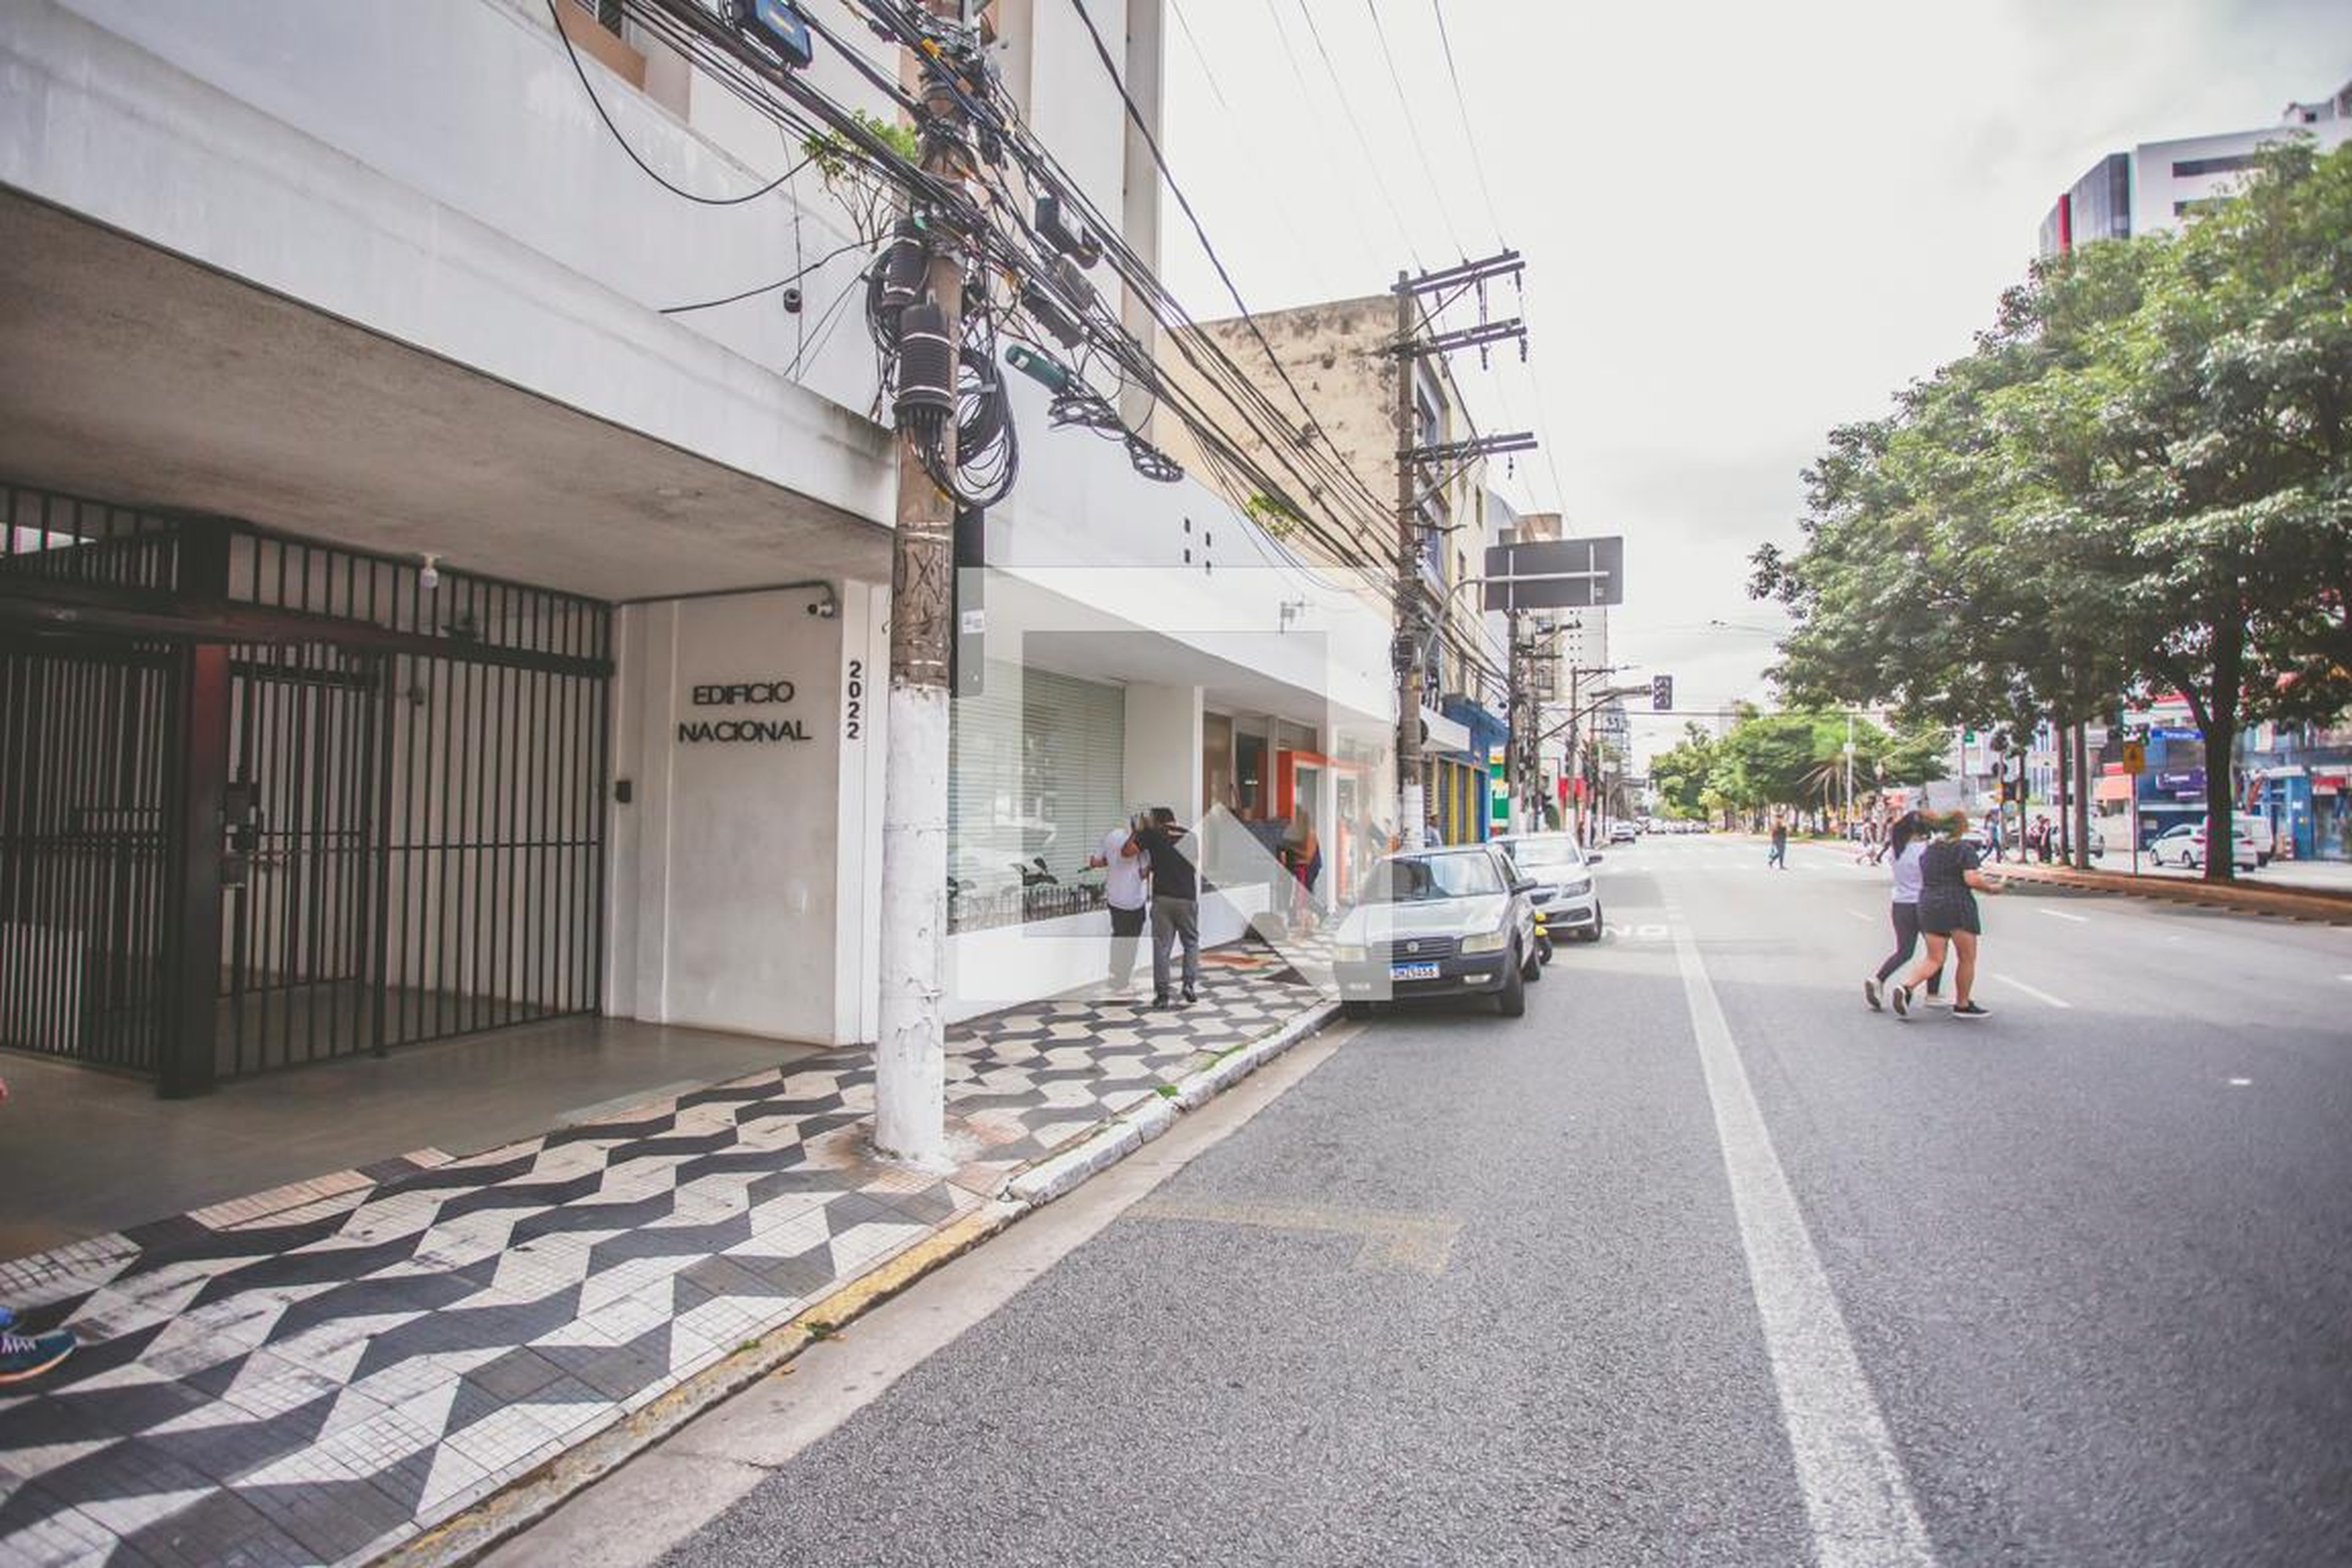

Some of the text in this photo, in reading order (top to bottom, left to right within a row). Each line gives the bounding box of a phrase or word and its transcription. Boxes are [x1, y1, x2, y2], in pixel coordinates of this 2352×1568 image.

[693, 681, 795, 706] EDIFICIO
[846, 661, 862, 739] 2022
[679, 720, 812, 743] NACIONAL
